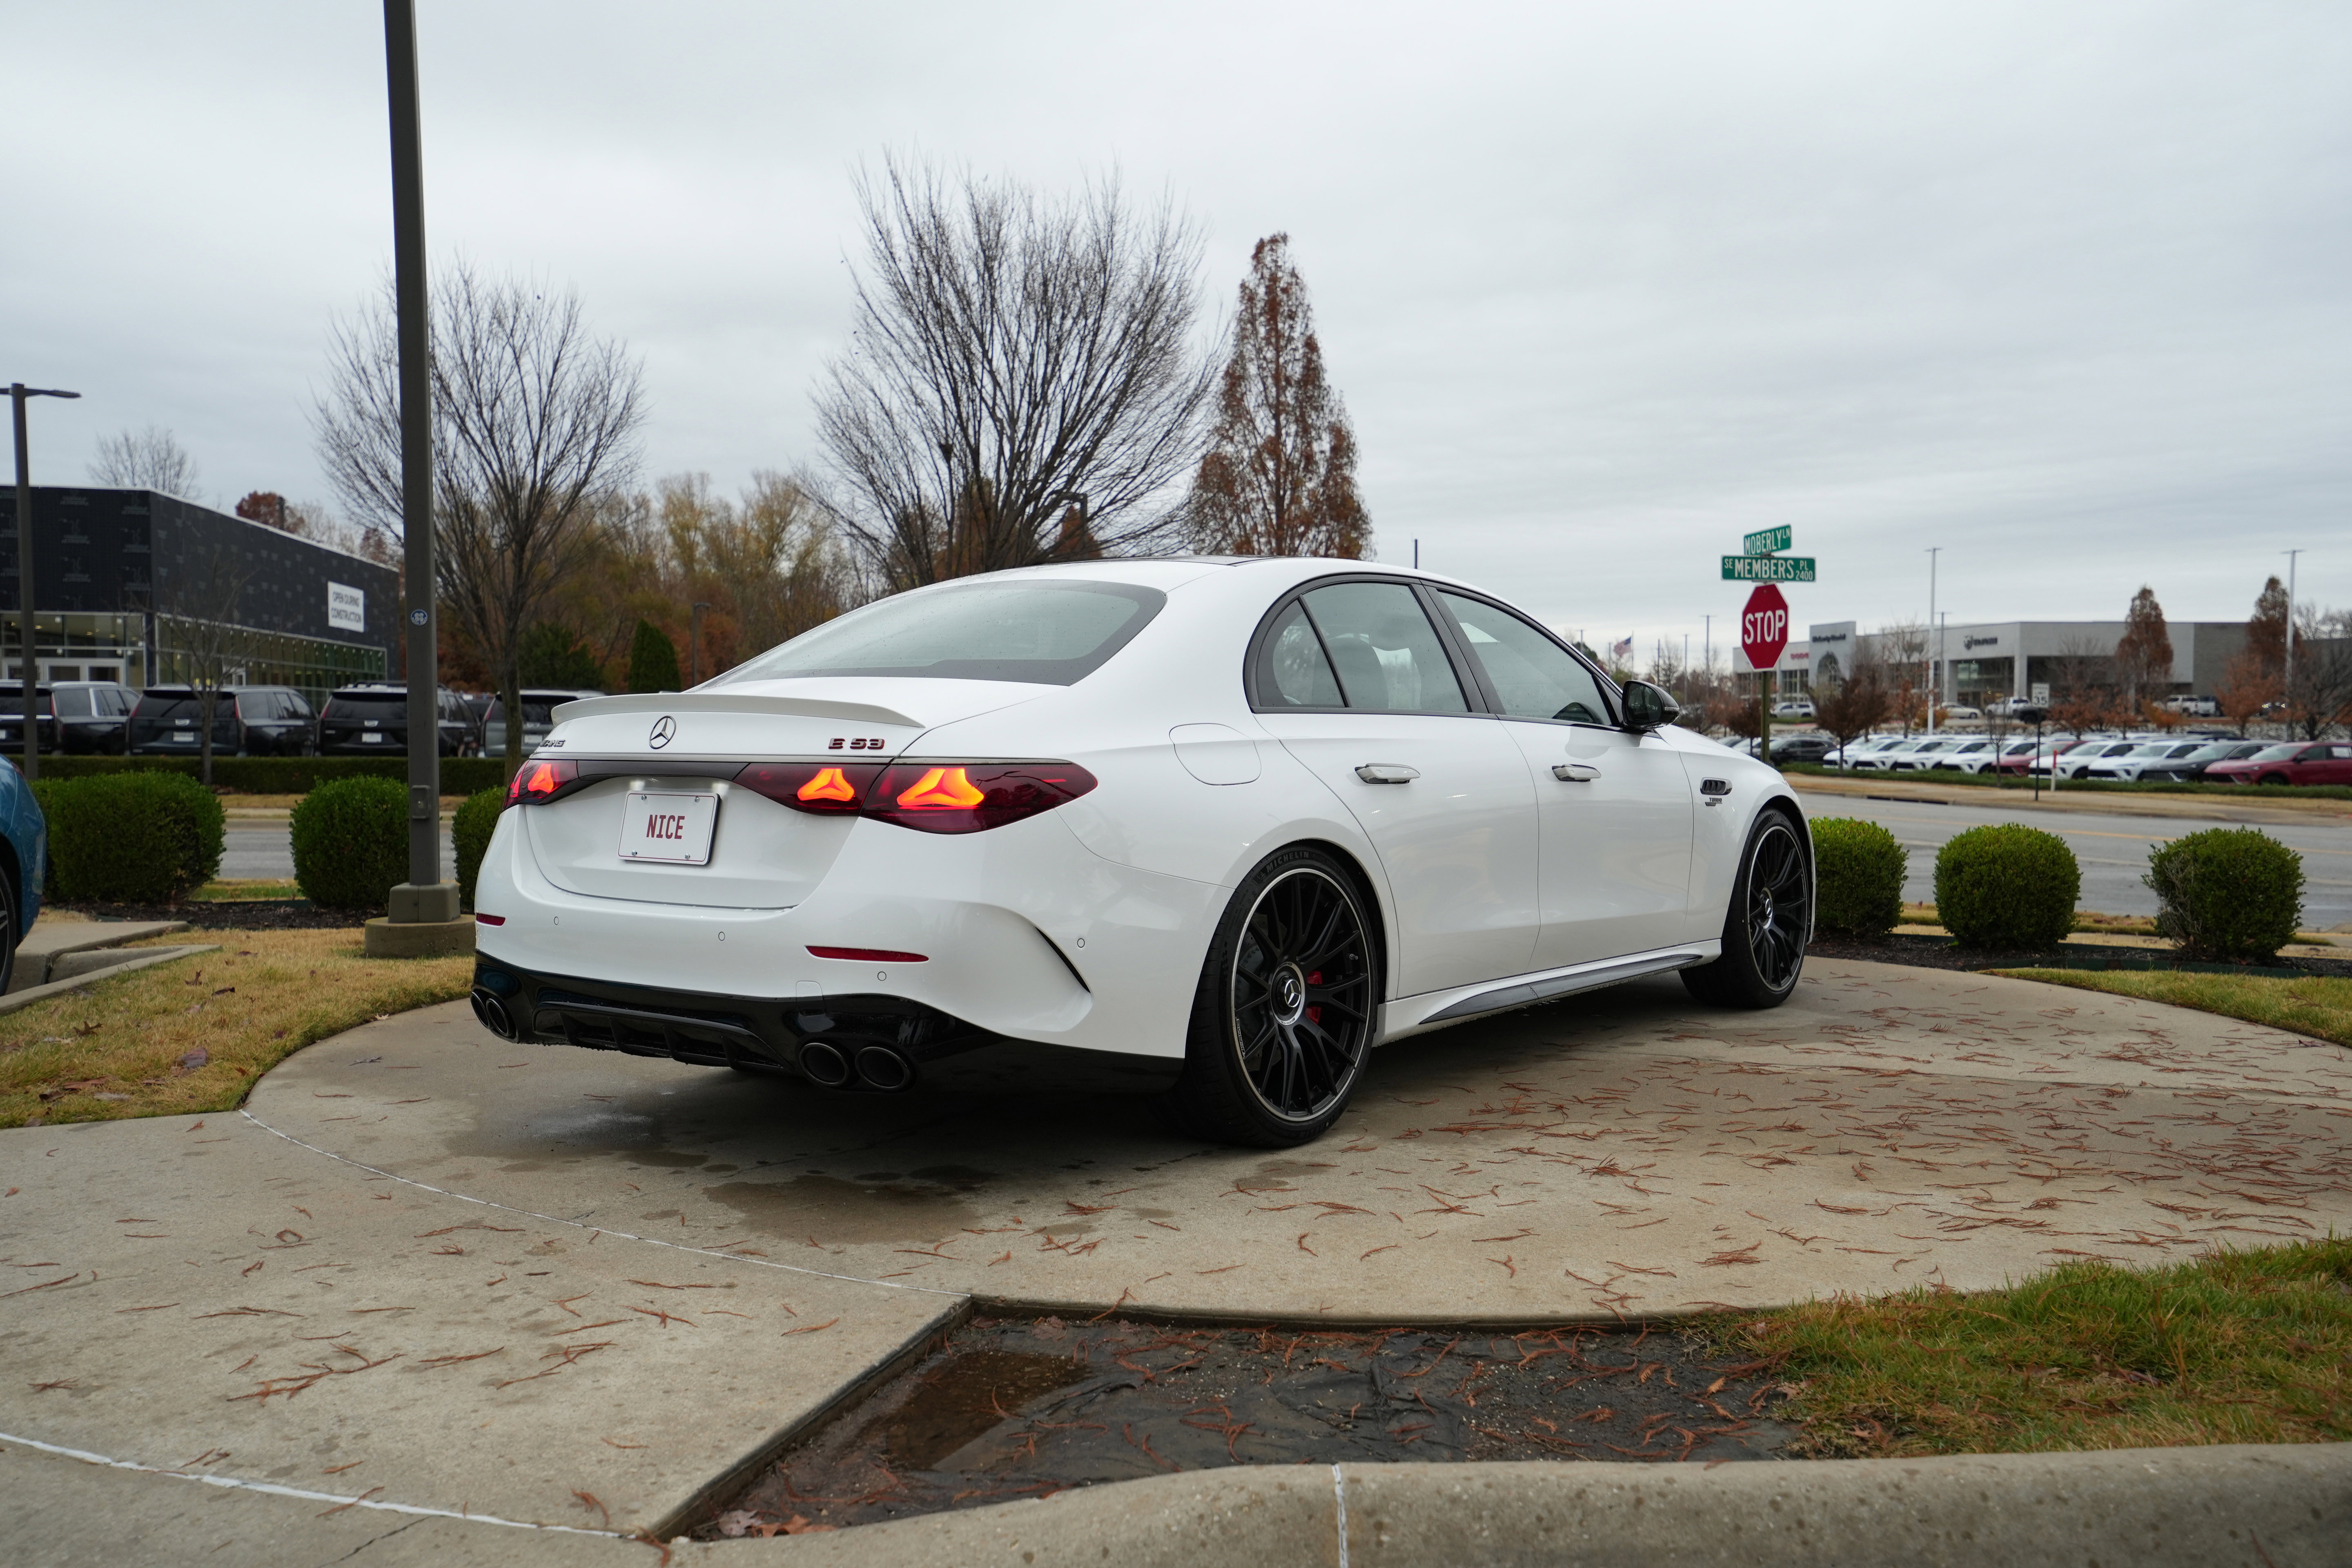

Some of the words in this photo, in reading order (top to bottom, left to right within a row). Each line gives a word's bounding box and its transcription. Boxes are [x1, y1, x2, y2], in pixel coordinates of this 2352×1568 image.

[1745, 528, 1782, 555] MOBERLY
[1782, 527, 1790, 539] LN
[1724, 558, 1733, 569] SE
[1735, 559, 1794, 579] MEMBERS
[1800, 560, 1809, 570] PL
[1795, 570, 1813, 580] 2400
[1744, 609, 1786, 645] STOP
[2034, 696, 2047, 706] 35
[828, 738, 845, 749] E
[850, 738, 885, 750] 53
[646, 814, 685, 840] NICE
[1266, 851, 1310, 873] MICHELIN
